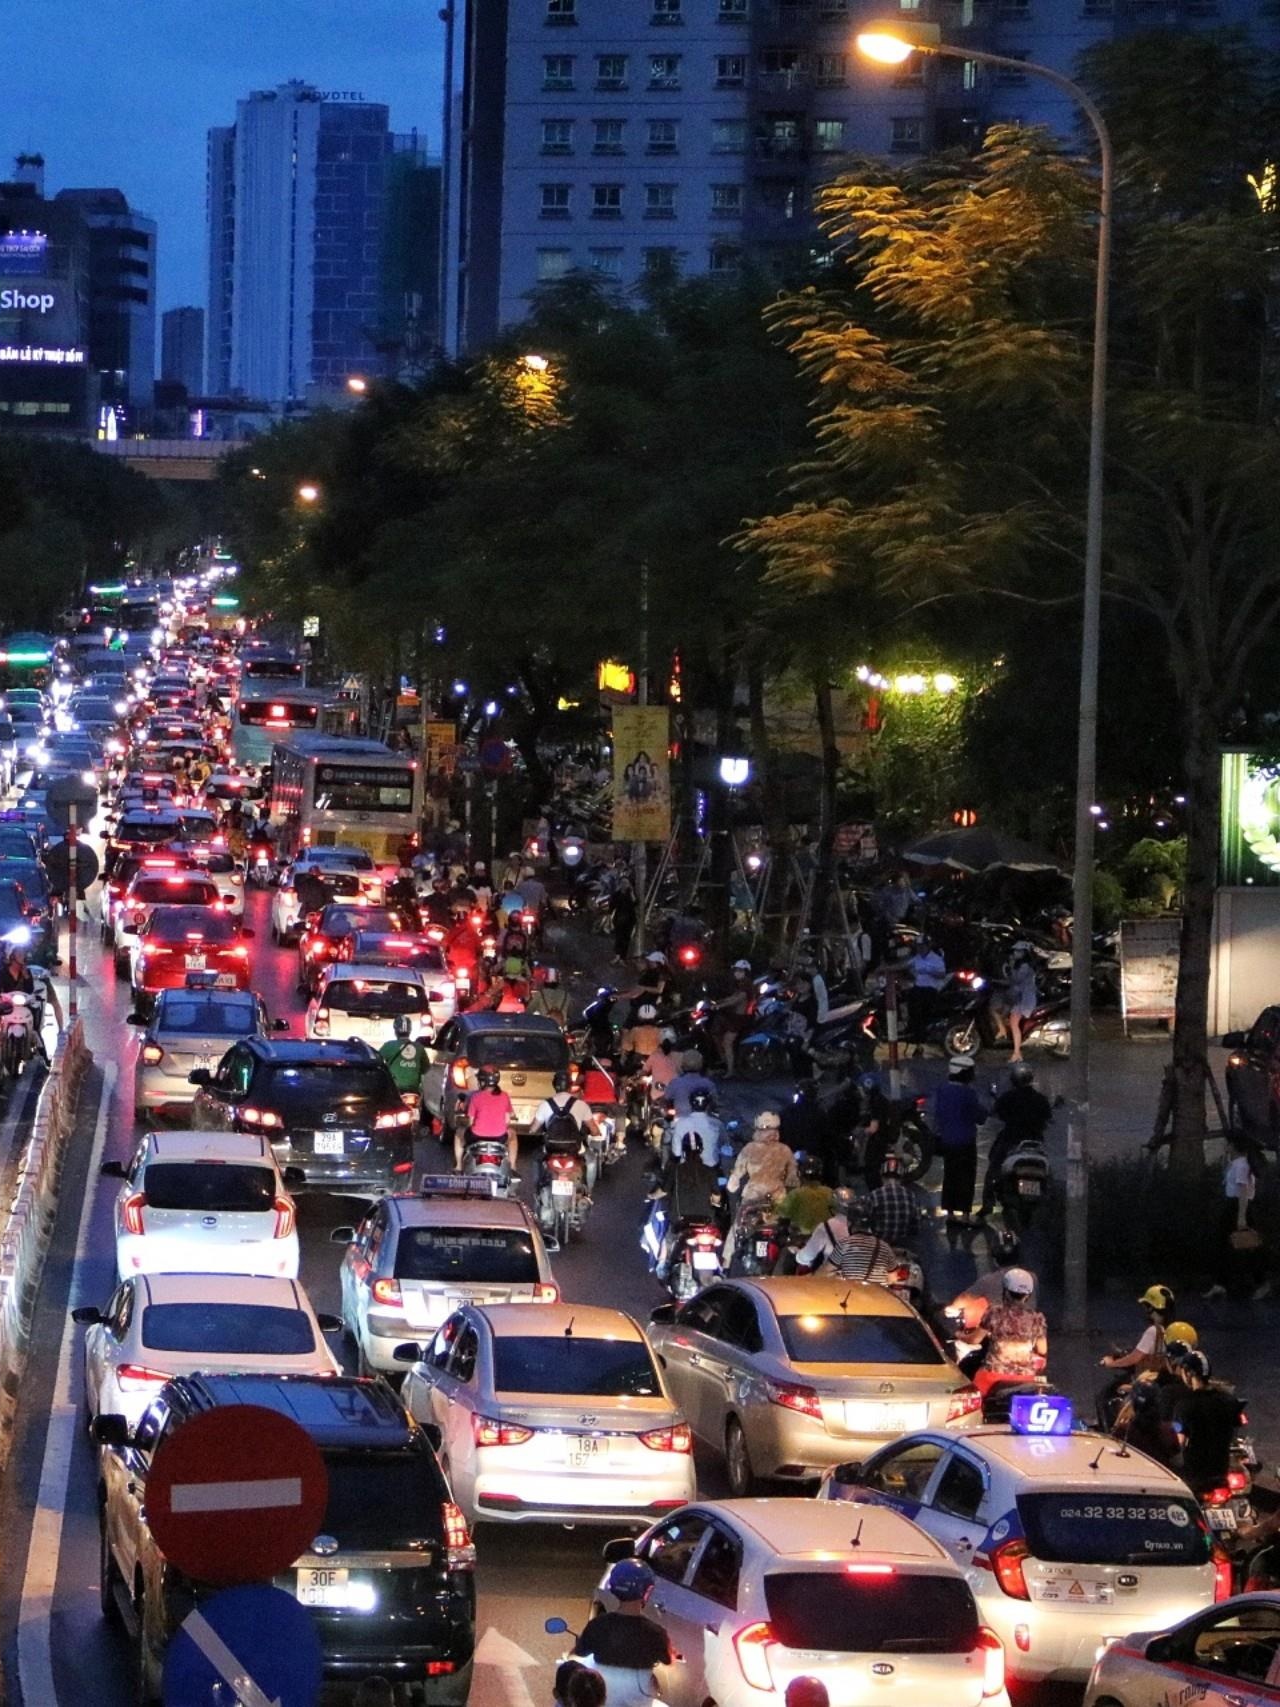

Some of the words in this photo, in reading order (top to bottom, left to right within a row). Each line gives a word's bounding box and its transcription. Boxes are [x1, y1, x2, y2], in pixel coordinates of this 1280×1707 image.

[1, 290, 54, 313] Shop
[1028, 1402, 1059, 1432] G7
[578, 1439, 599, 1453] 18A
[569, 1453, 590, 1466] 157
[1106, 1507, 1125, 1519] 32
[1127, 1507, 1147, 1520] 32
[1149, 1508, 1167, 1520] 32
[310, 1571, 337, 1587] 30E
[872, 1663, 894, 1675] KIA
